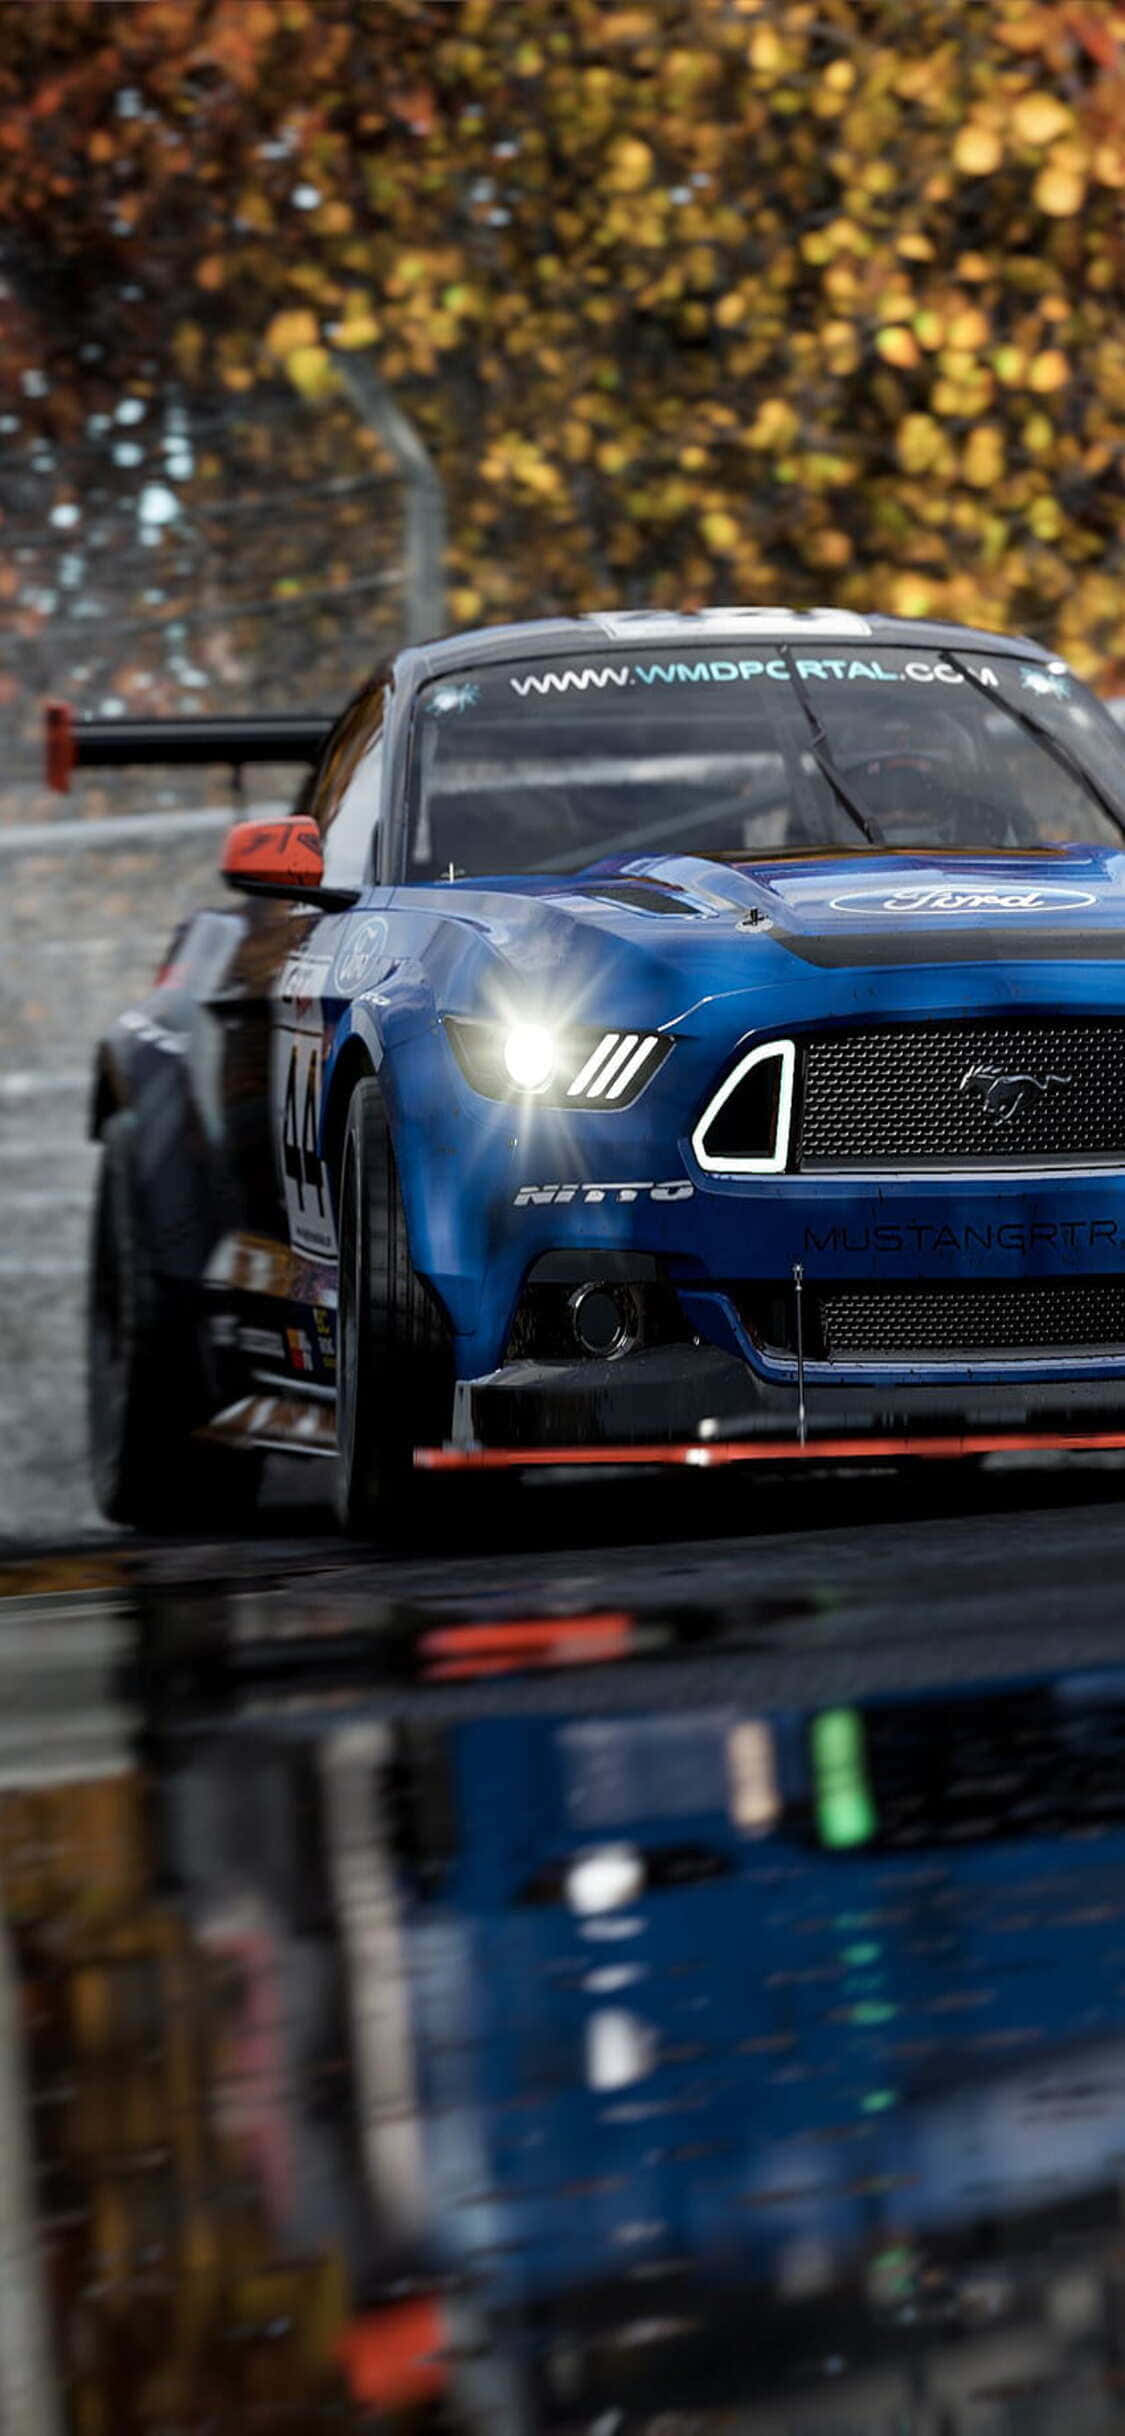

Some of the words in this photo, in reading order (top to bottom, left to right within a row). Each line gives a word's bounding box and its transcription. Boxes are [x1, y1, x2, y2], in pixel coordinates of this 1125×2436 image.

[883, 888, 1045, 911] Ford
[284, 1045, 325, 1219] 44
[513, 1180, 694, 1206] NITTO
